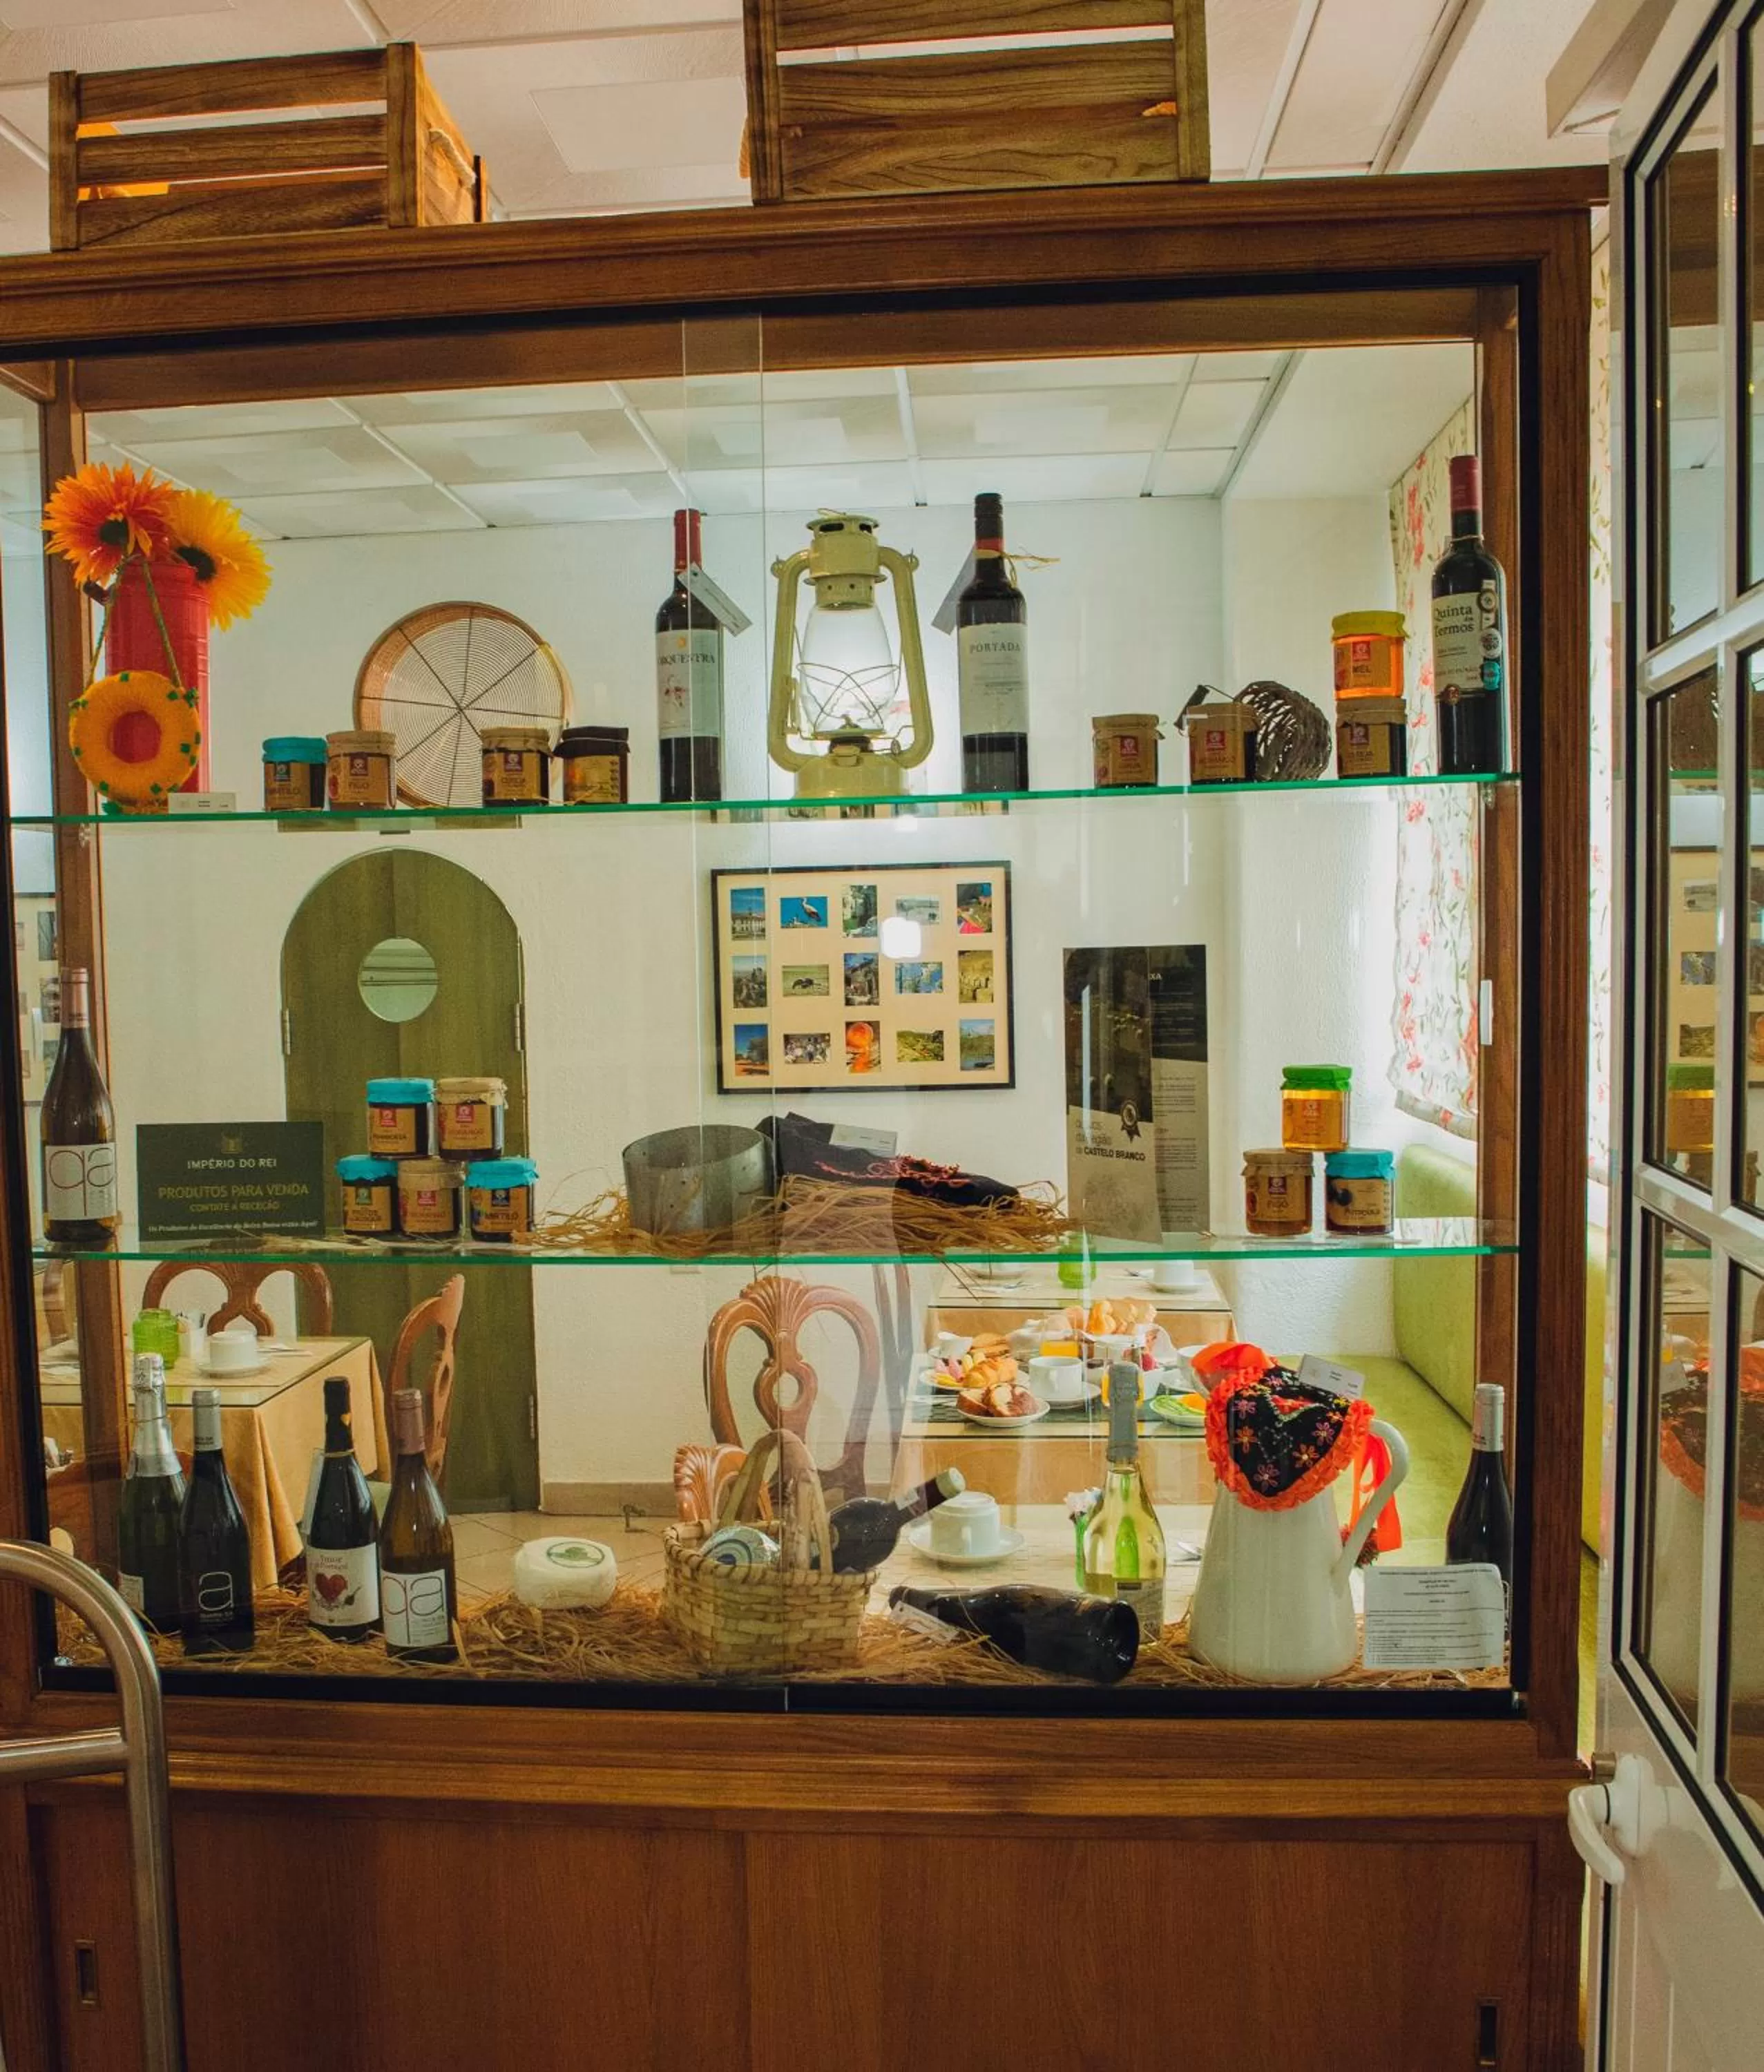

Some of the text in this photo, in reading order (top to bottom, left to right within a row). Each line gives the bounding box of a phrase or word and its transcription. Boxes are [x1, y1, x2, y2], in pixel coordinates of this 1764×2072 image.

[969, 642, 1020, 653] PORTADA
[1084, 1147, 1114, 1158] CASTELO
[1115, 1150, 1146, 1161] BRANCO
[187, 1158, 277, 1169] IMPÉRIO DO REI
[157, 1183, 310, 1199] PRODUTOS PARA VENDA
